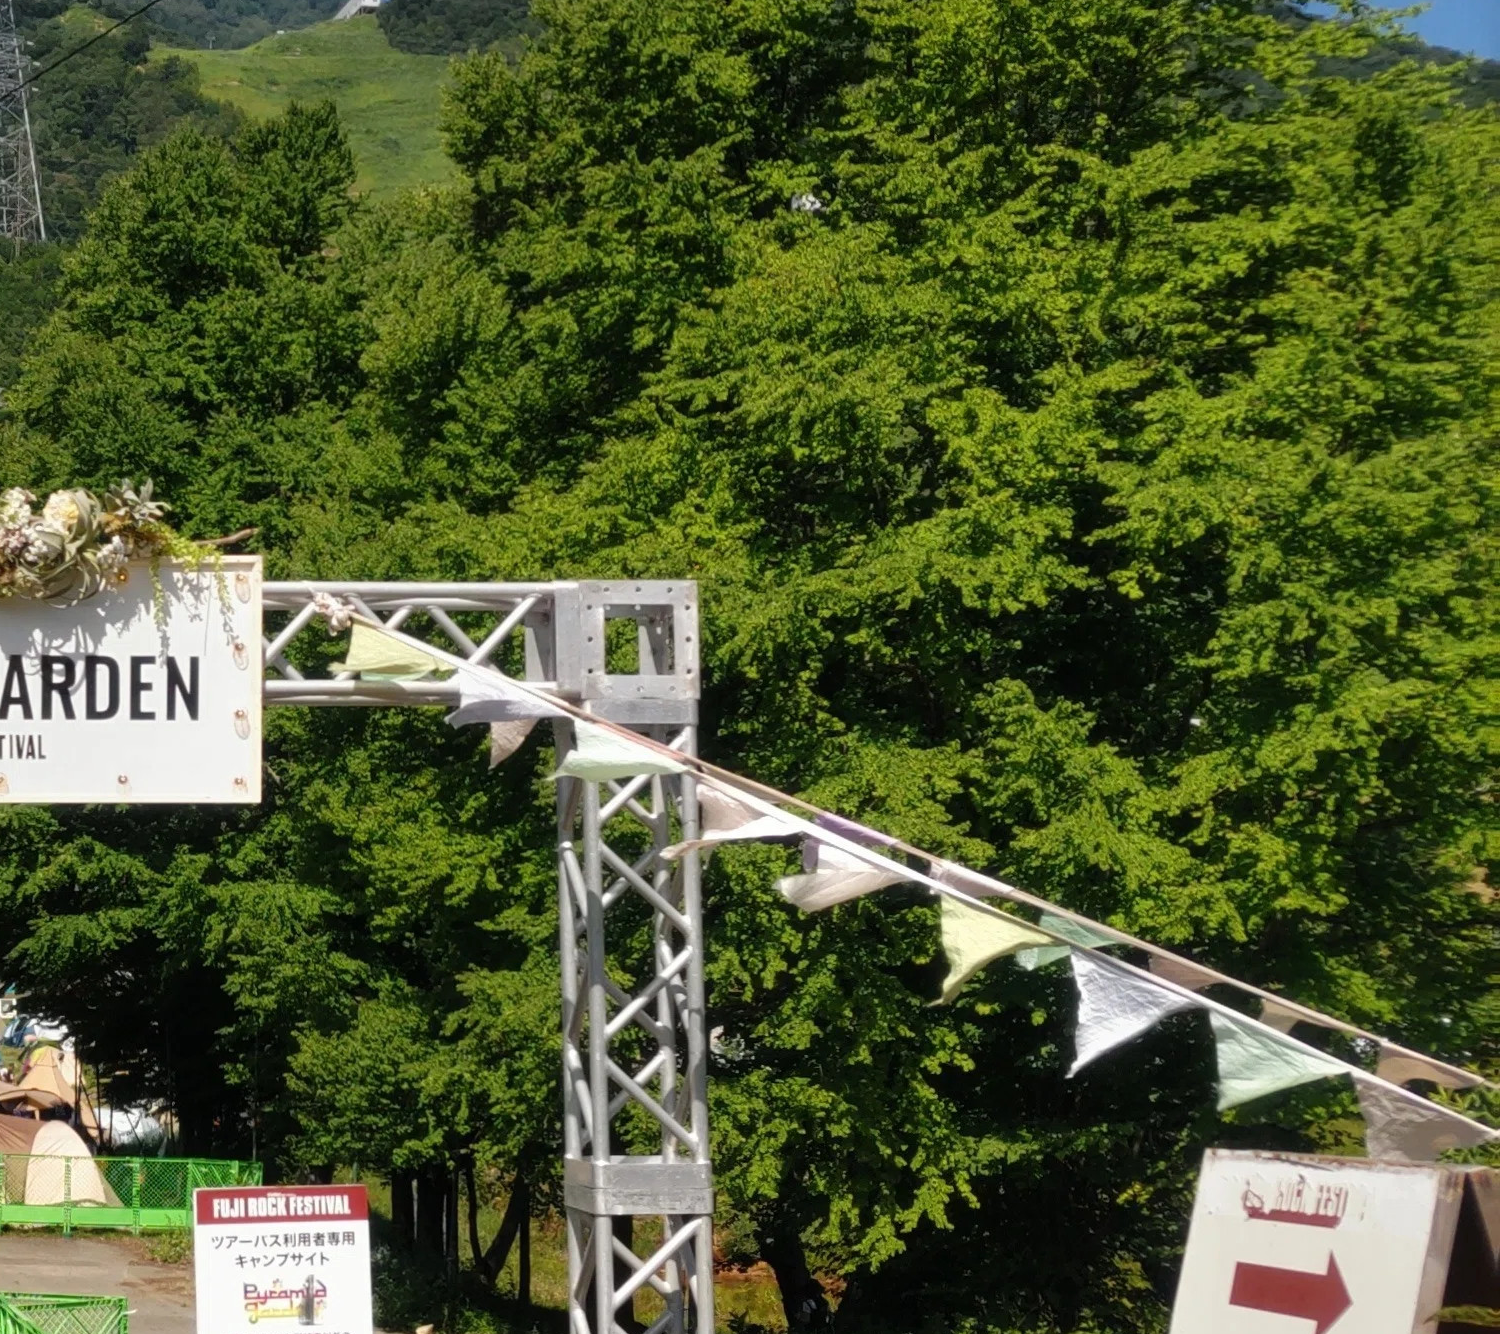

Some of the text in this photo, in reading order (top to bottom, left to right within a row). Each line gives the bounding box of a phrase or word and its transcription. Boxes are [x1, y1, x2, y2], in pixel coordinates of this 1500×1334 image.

[213, 1194, 352, 1219] FUJI ROCK FESTIVAL
[211, 1231, 356, 1250] ツアーバス利用者専用
[235, 1252, 330, 1269] キャンプサイト
